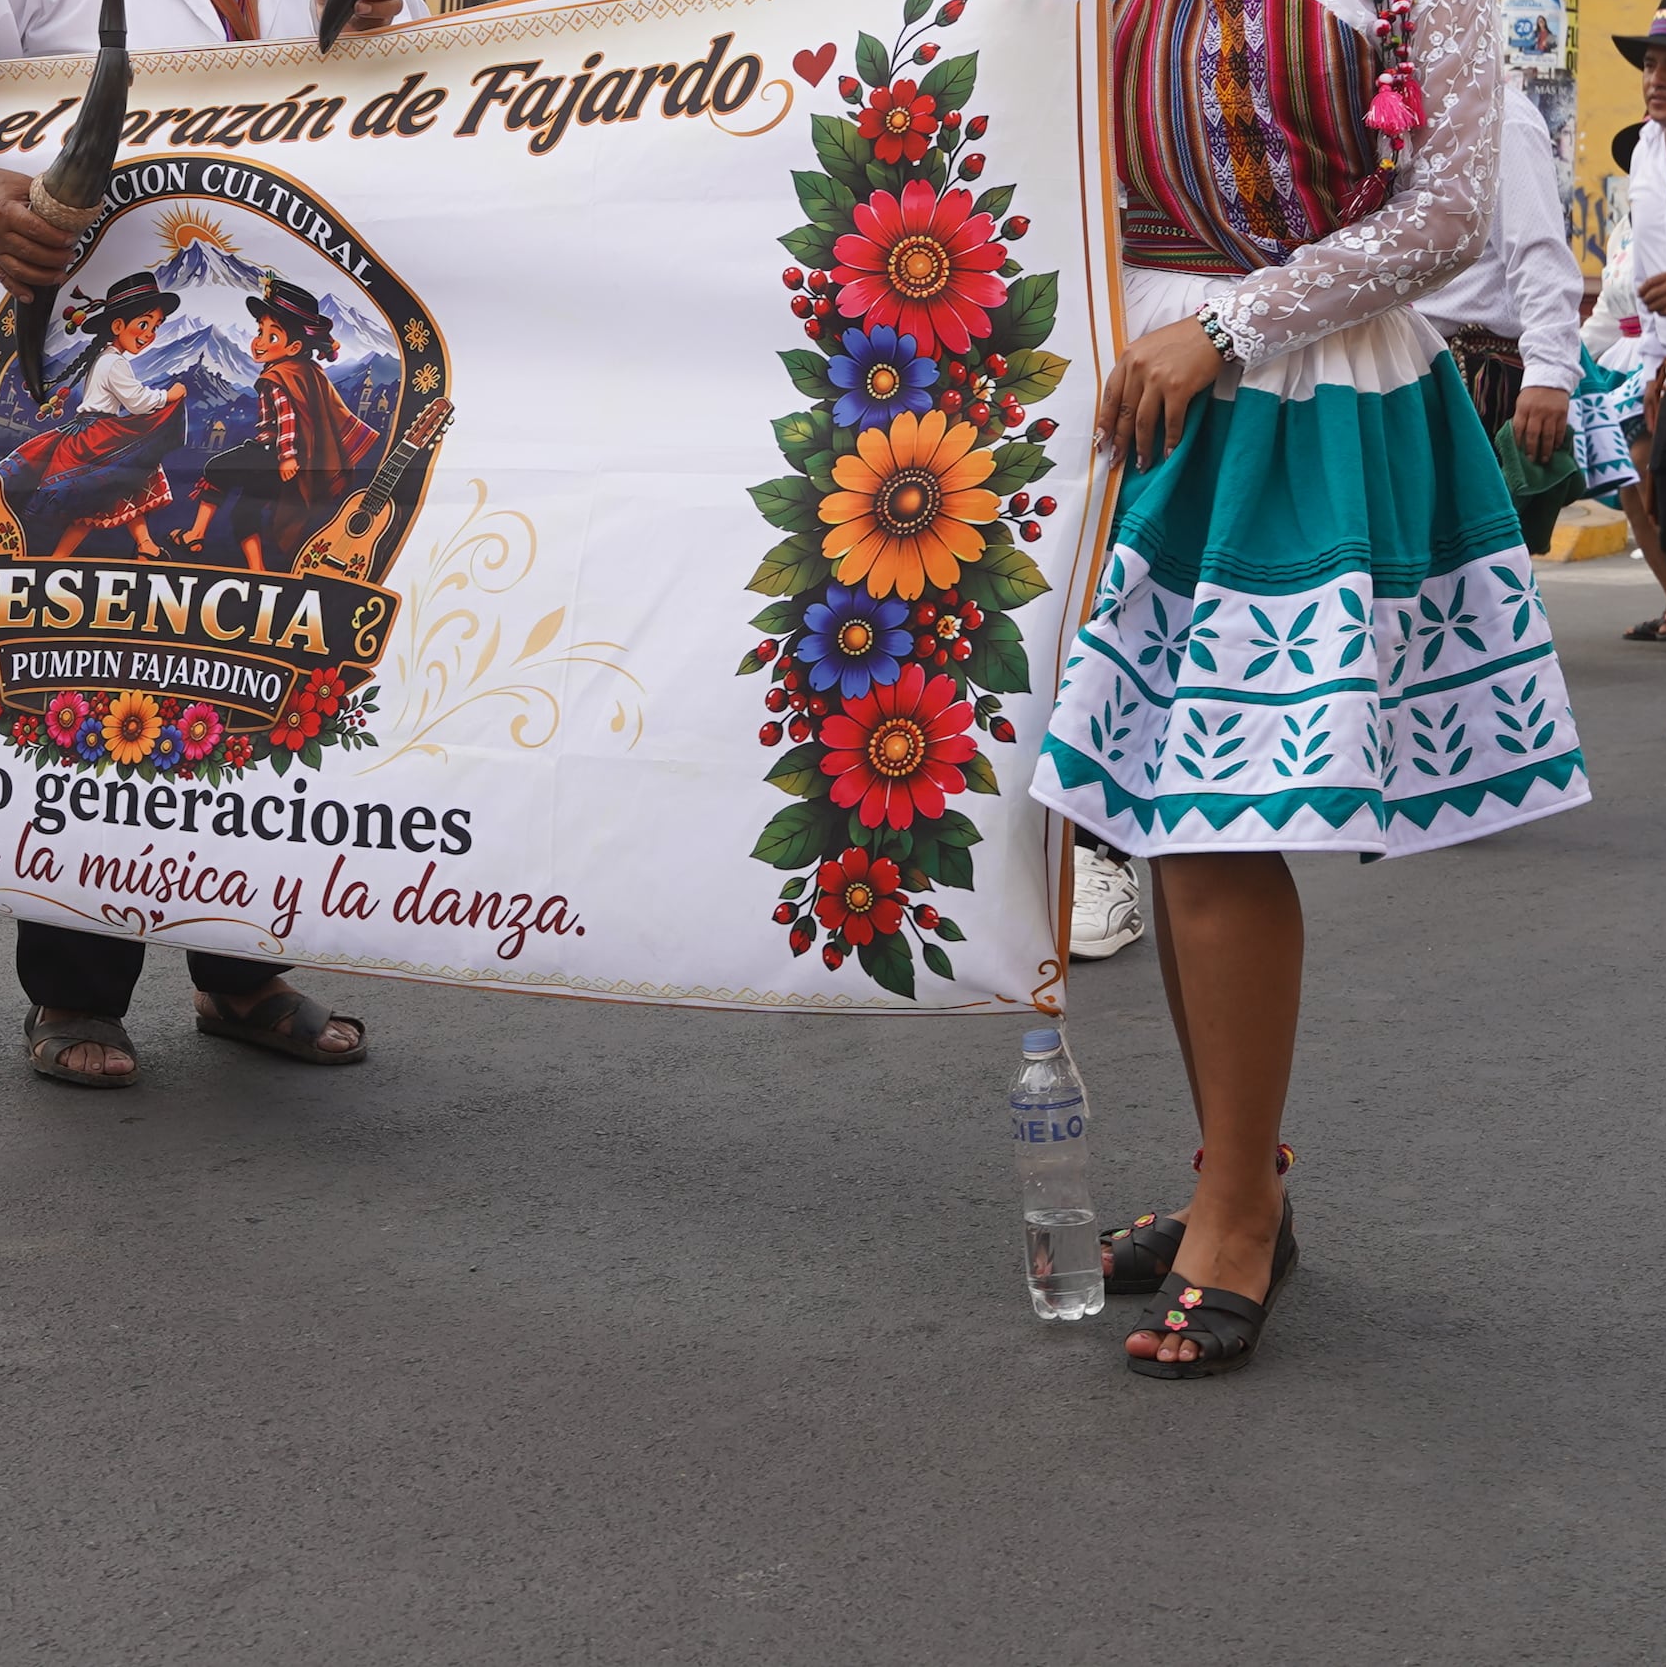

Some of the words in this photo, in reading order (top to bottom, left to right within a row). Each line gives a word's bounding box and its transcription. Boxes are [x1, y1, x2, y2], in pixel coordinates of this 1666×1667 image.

[1515, 21, 1531, 34] 28
[61, 81, 347, 153] orazón
[349, 71, 449, 139] de
[453, 31, 765, 156] Fajardo
[201, 163, 374, 287] CULTURAL
[10, 648, 124, 683] PUMPIN
[129, 652, 283, 704] FAJARDINO
[33, 772, 473, 856] generaciones
[15, 820, 65, 883] la
[79, 843, 258, 909] música
[271, 873, 303, 939] y
[321, 854, 380, 921] la
[393, 861, 587, 961] danza.
